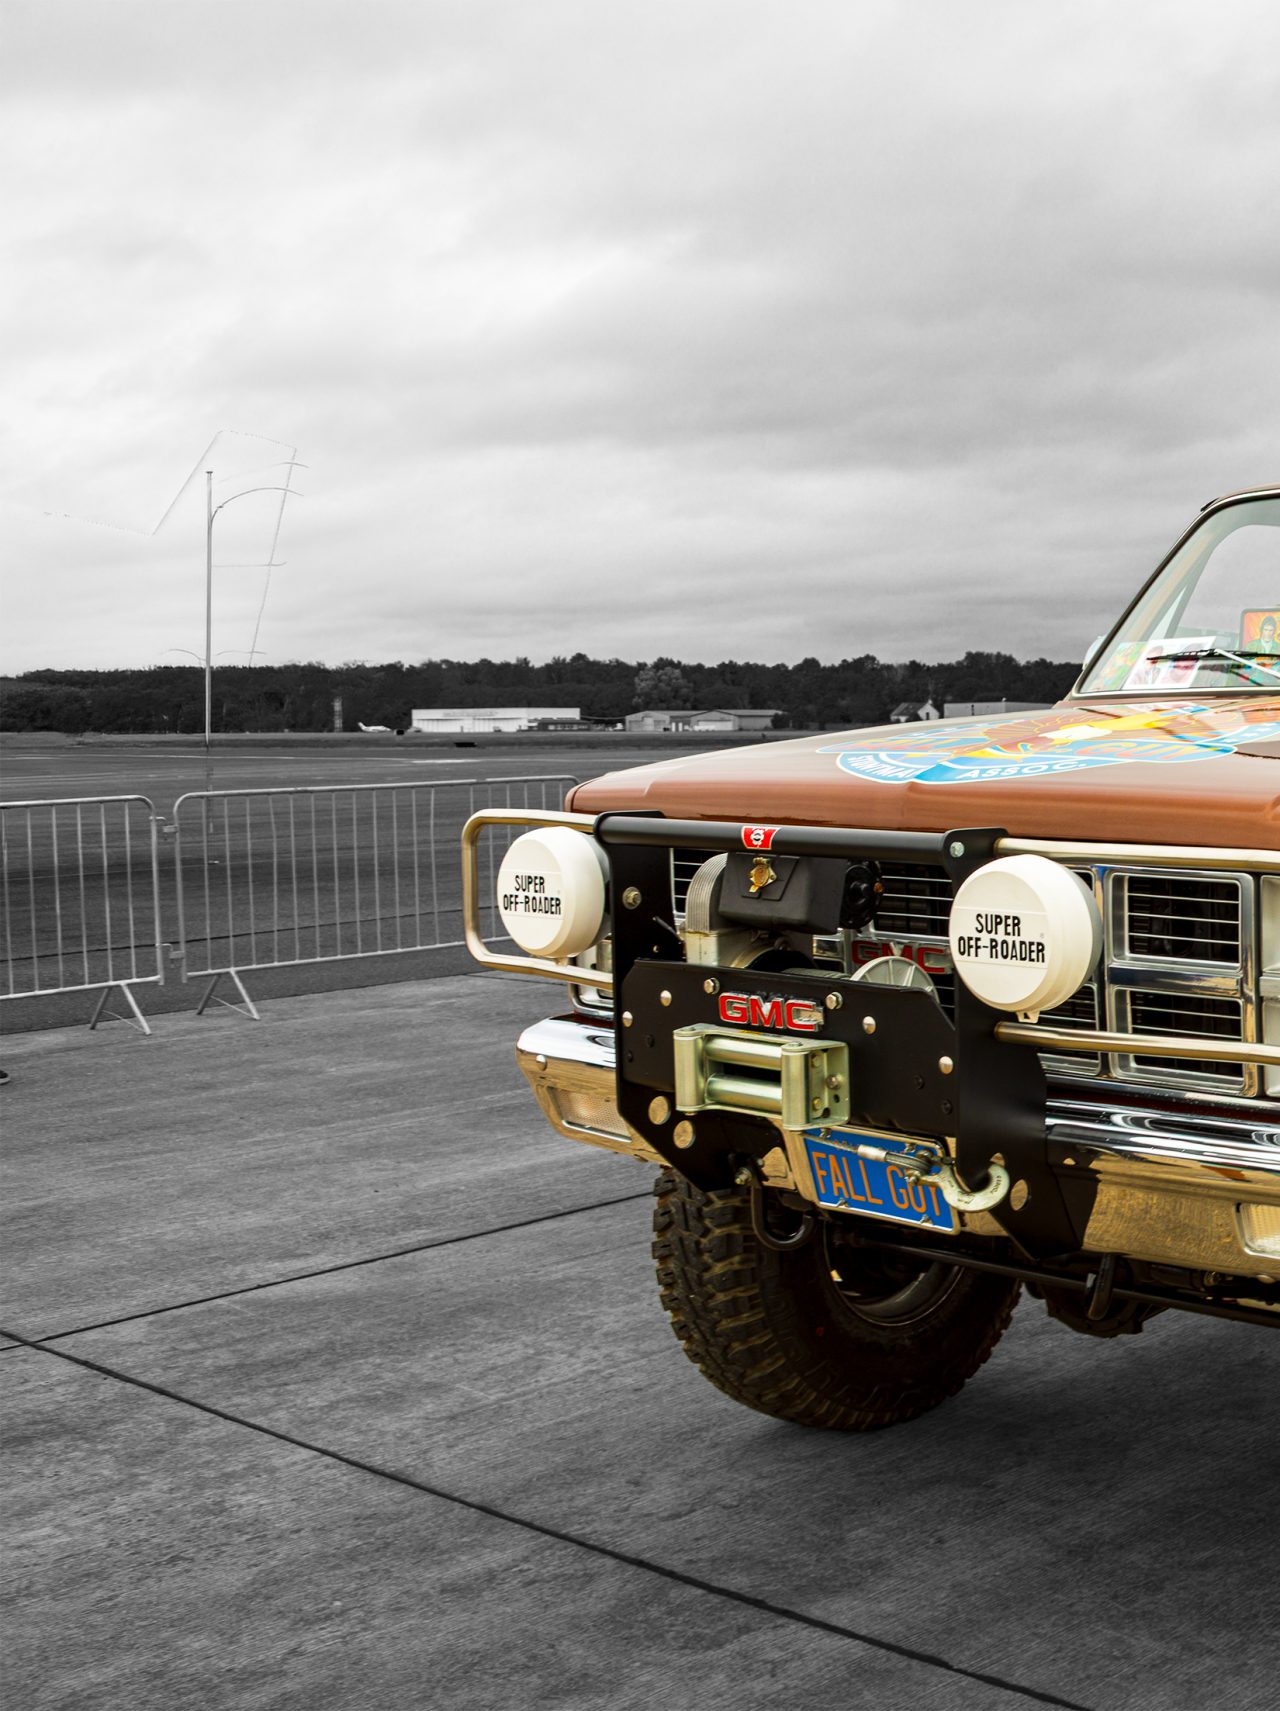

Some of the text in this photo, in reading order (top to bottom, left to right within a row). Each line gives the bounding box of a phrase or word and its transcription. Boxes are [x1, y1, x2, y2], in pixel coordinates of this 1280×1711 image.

[1075, 741, 1202, 760] GUY
[955, 760, 1087, 780] ASSOC.
[514, 874, 545, 894] SUPER
[503, 893, 562, 915] OFF-ROADER
[975, 913, 1021, 937] SUPER
[957, 935, 1045, 963] OFF-ROADER
[719, 992, 820, 1031] GMC
[812, 1152, 883, 1205] FALL
